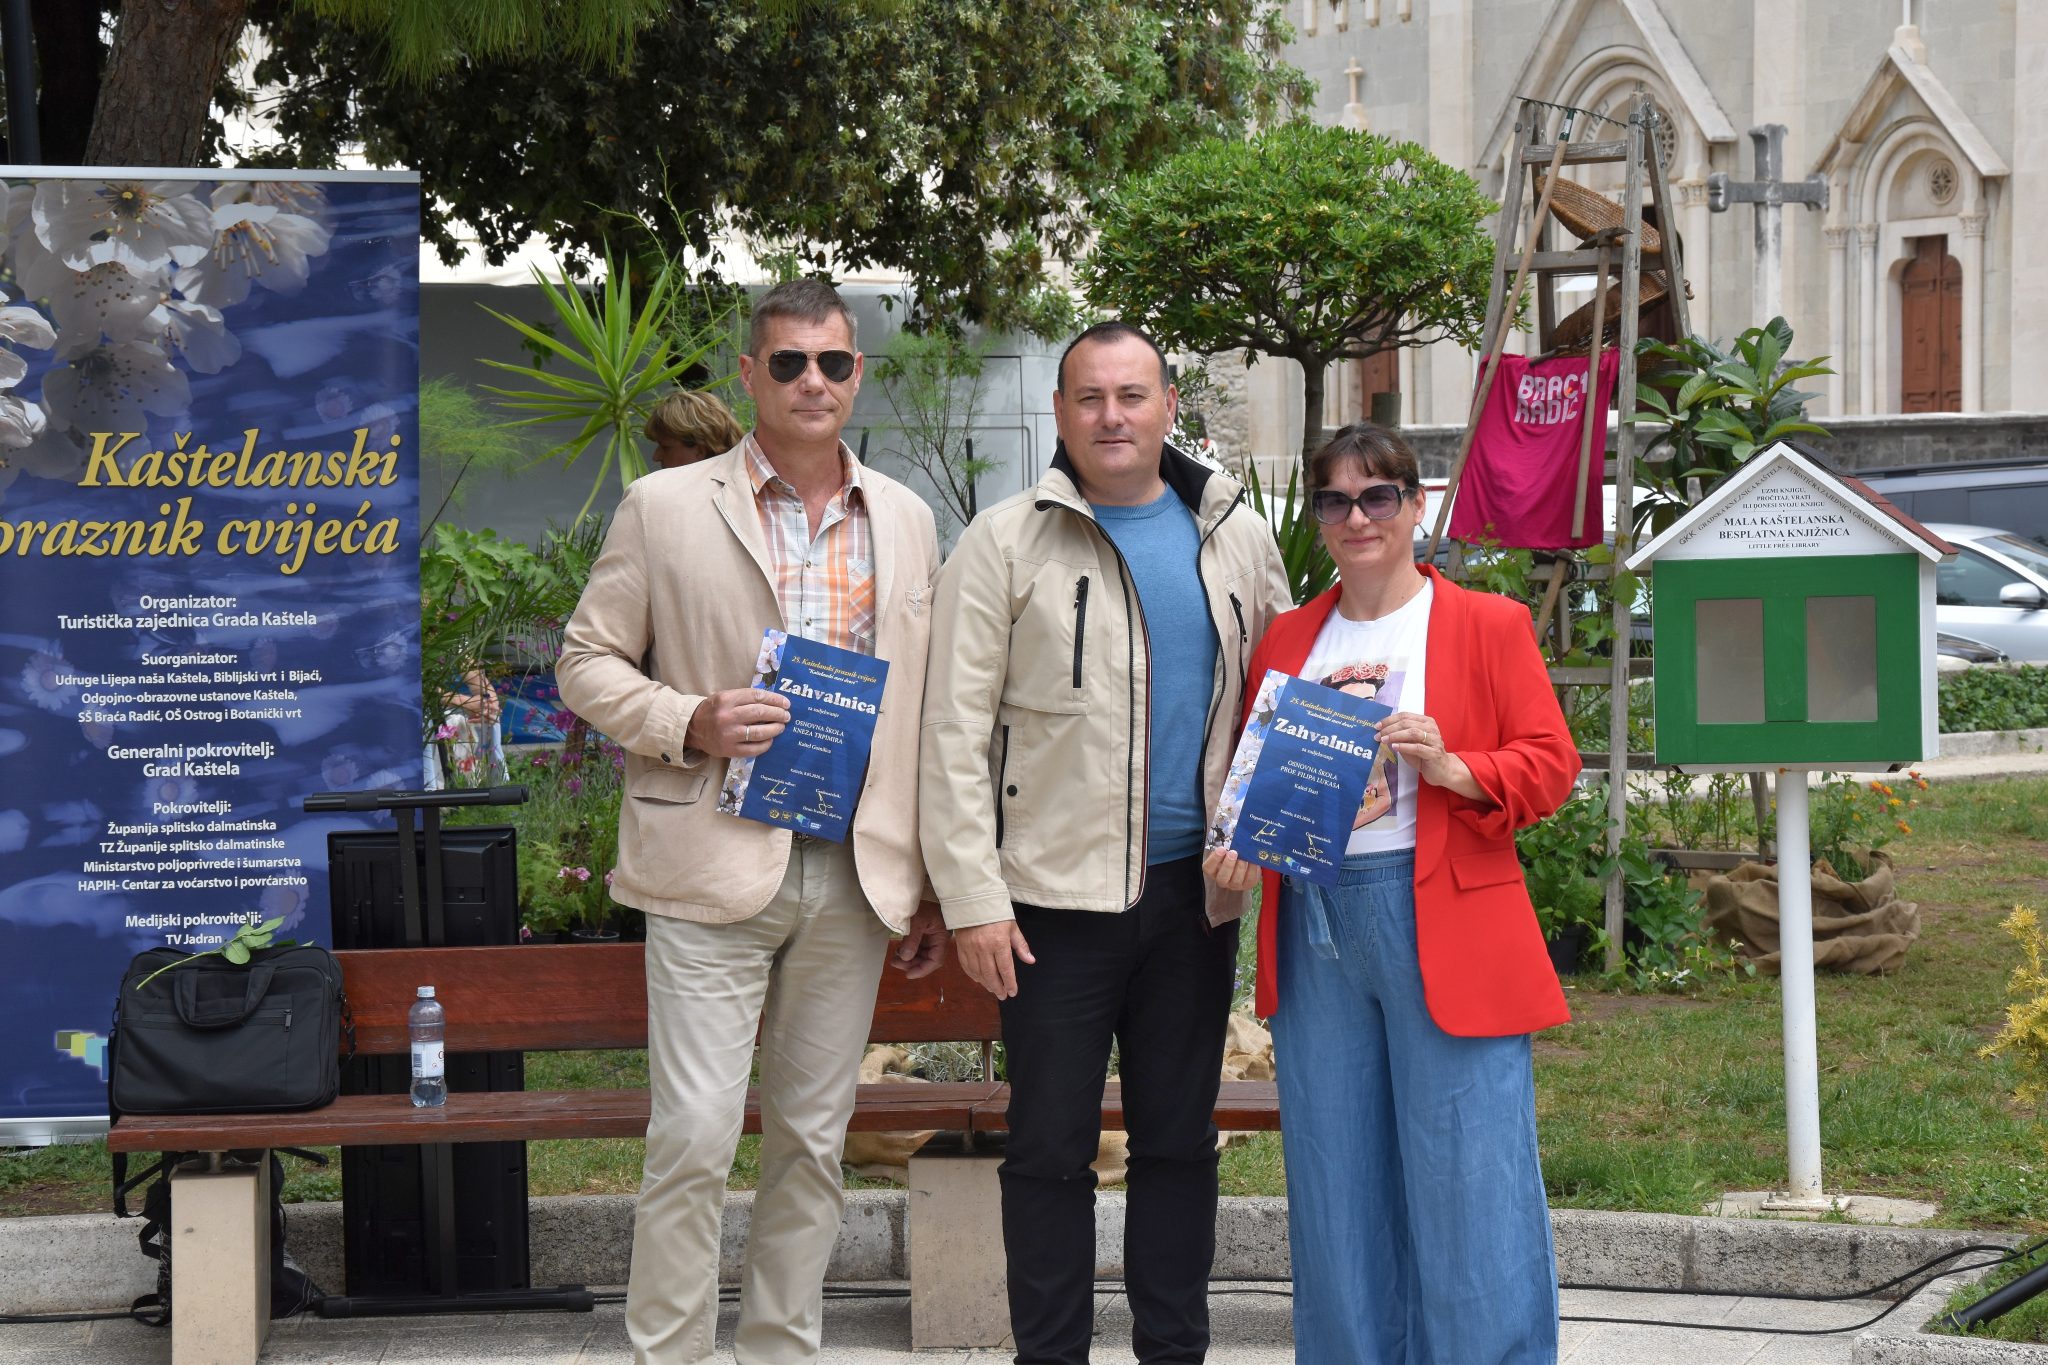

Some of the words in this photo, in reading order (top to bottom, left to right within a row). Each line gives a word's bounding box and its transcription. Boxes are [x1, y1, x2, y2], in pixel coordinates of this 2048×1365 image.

[78, 428, 402, 487] Kaštelanski
[1724, 518, 1757, 526] MALA
[1761, 515, 1844, 525] KAŠTELANSKA
[217, 500, 399, 575] cvijeća
[1720, 530, 1784, 539] BESPLATNA
[1788, 527, 1850, 537] KNJIŽNICA
[140, 594, 236, 614] Organizator:
[58, 614, 132, 629] Turistička
[135, 613, 208, 632] zajednica
[212, 612, 258, 626] Grada
[262, 610, 316, 626] Kaštela
[142, 652, 238, 668] Suorganizator:
[56, 674, 100, 688] Udruge
[102, 673, 135, 688] Lijepa
[139, 672, 164, 683] naša
[168, 672, 212, 684] Kaštela,
[213, 672, 258, 685] Biblijski
[260, 672, 276, 681] vrt
[281, 671, 284, 681] i
[289, 670, 322, 684] Bijaći,
[82, 691, 198, 707] Odgojno-obrazovne
[200, 692, 252, 702] ustanove
[254, 688, 298, 700] Kaštela,
[779, 678, 876, 714] Zahvalnica
[78, 710, 93, 722] SŠ
[94, 711, 126, 722] Braća
[128, 710, 162, 722] Radić,
[166, 707, 181, 720] OŠ
[184, 710, 222, 722] Ostrog
[225, 708, 228, 719] i
[231, 707, 284, 719] Botanički
[284, 708, 301, 718] vrt
[795, 720, 824, 731] OSNOVNA
[1274, 718, 1372, 759] Zahvalnica
[108, 744, 182, 760] Generalni
[186, 742, 275, 762] pokrovitelj:
[144, 762, 180, 776] Grad
[184, 760, 239, 776] Kaštela
[1288, 760, 1316, 774] OSNOVNA
[154, 800, 232, 816] Pokrovitelji:
[108, 822, 159, 836] Županija
[160, 821, 204, 835] splitsko
[206, 820, 276, 832] dalmatinska
[100, 842, 115, 852] TZ
[116, 841, 168, 854] Županije
[170, 840, 214, 854] splitsko
[216, 837, 286, 850] dalmatinske
[84, 862, 156, 872] Ministarstvo
[158, 858, 234, 872] poljoprivrede
[238, 858, 240, 868] i
[242, 858, 302, 868] šumarstva
[78, 880, 119, 891] HAPIH-
[122, 879, 160, 890] Centar
[161, 880, 174, 889] za
[176, 878, 232, 888] voćarstvo
[234, 876, 238, 887] i
[240, 876, 308, 889] povrćarstvo
[126, 913, 180, 930] Medijski
[166, 934, 181, 944] TV
[184, 934, 222, 945] Jadran
